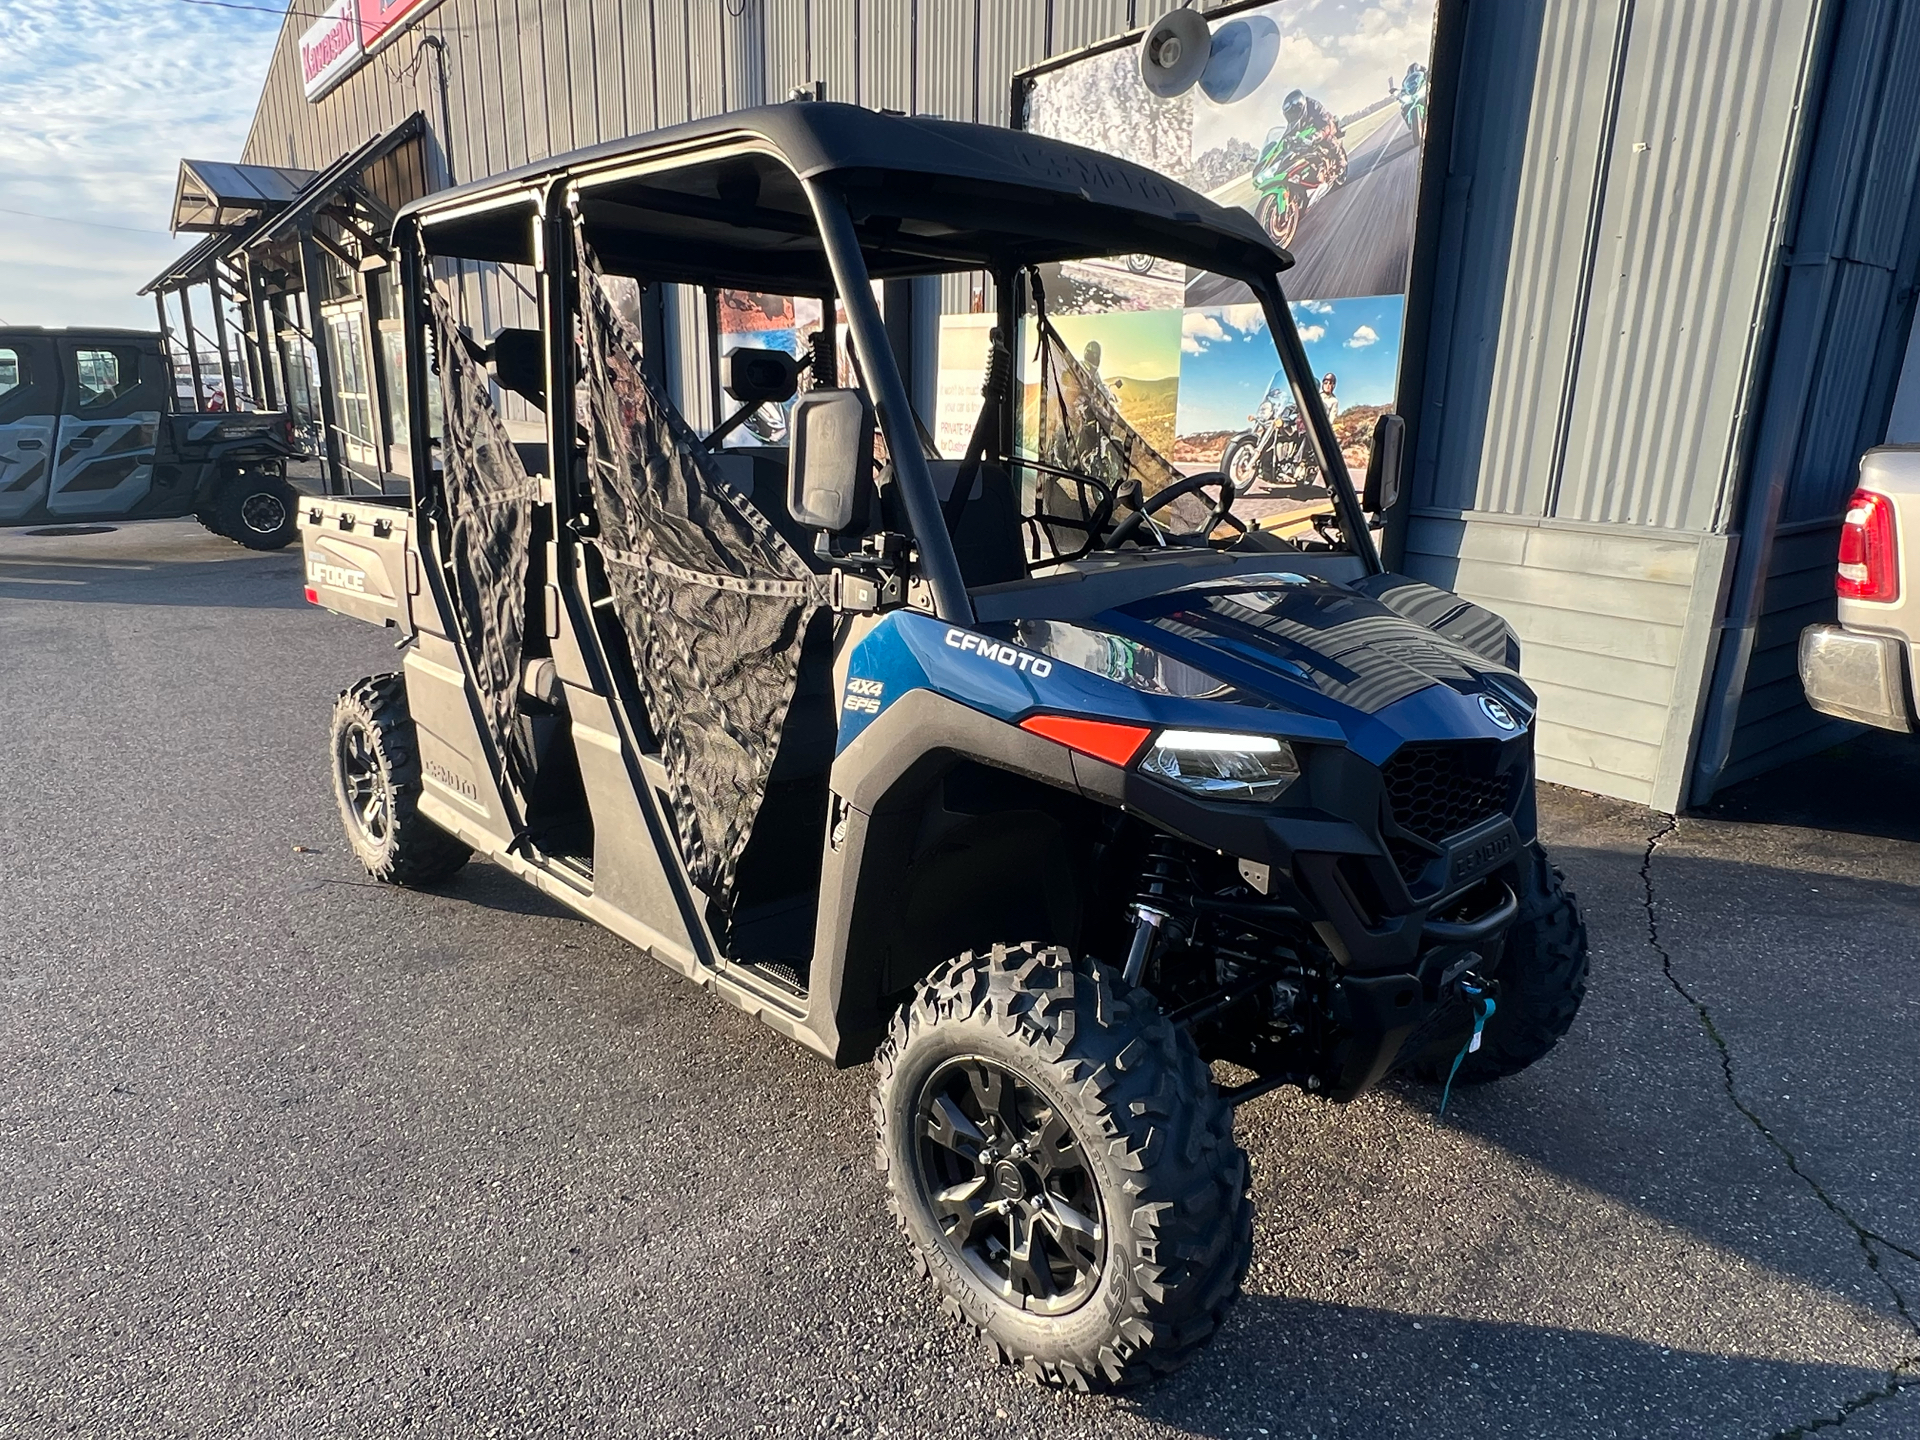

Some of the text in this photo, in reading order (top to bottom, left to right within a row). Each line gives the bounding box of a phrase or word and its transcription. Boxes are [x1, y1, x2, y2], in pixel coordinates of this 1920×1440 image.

[302, 1, 355, 84] Kawasaki
[940, 421, 964, 436] PRIVATE
[308, 561, 365, 593] UFORCE
[945, 628, 1053, 678] CFMOTO
[843, 694, 882, 714] EPS
[846, 677, 885, 697] 4X4
[1455, 833, 1512, 877] CFMOTO
[1102, 1242, 1131, 1327] CST
